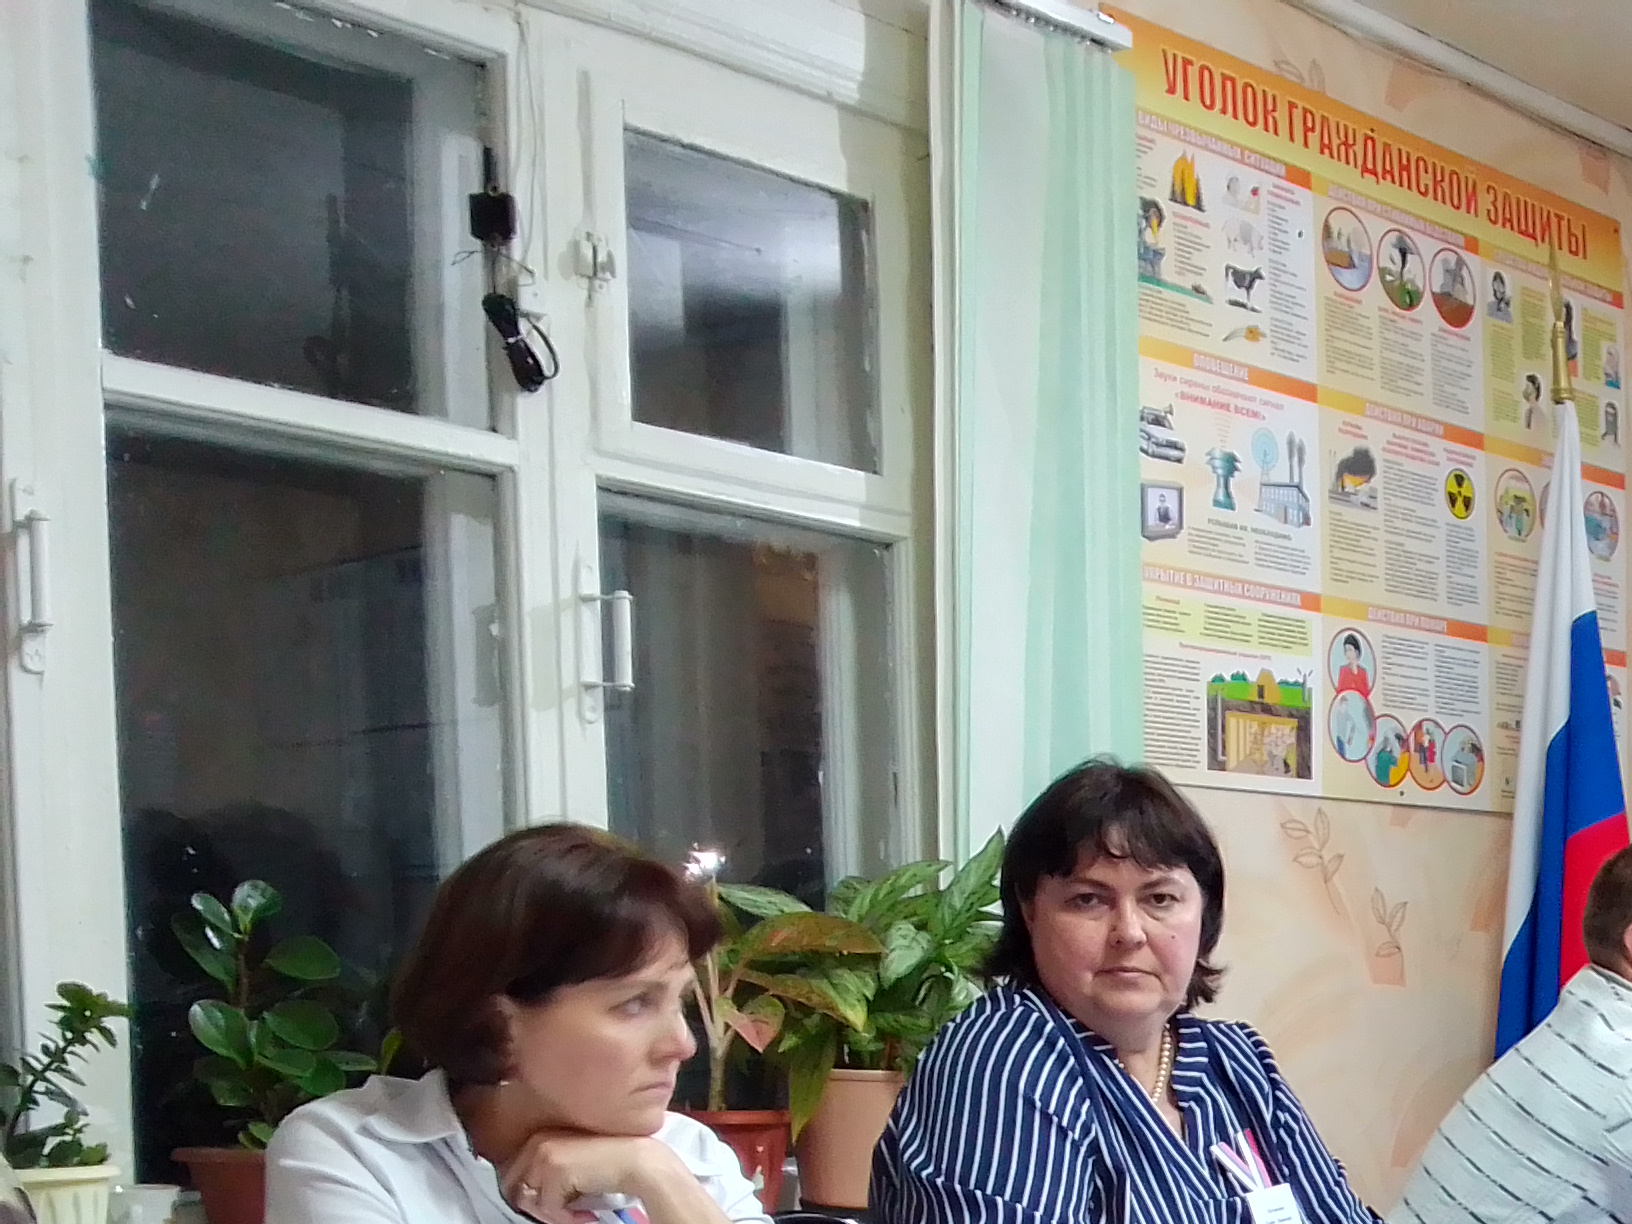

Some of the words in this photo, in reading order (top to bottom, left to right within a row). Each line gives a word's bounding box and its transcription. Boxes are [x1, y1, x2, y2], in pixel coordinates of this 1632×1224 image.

[1162, 48, 1280, 137] УГОЛОК
[1287, 99, 1479, 218] ГРАЖДАНСКОЙ
[1486, 183, 1588, 260] ЗАЩИТЫ
